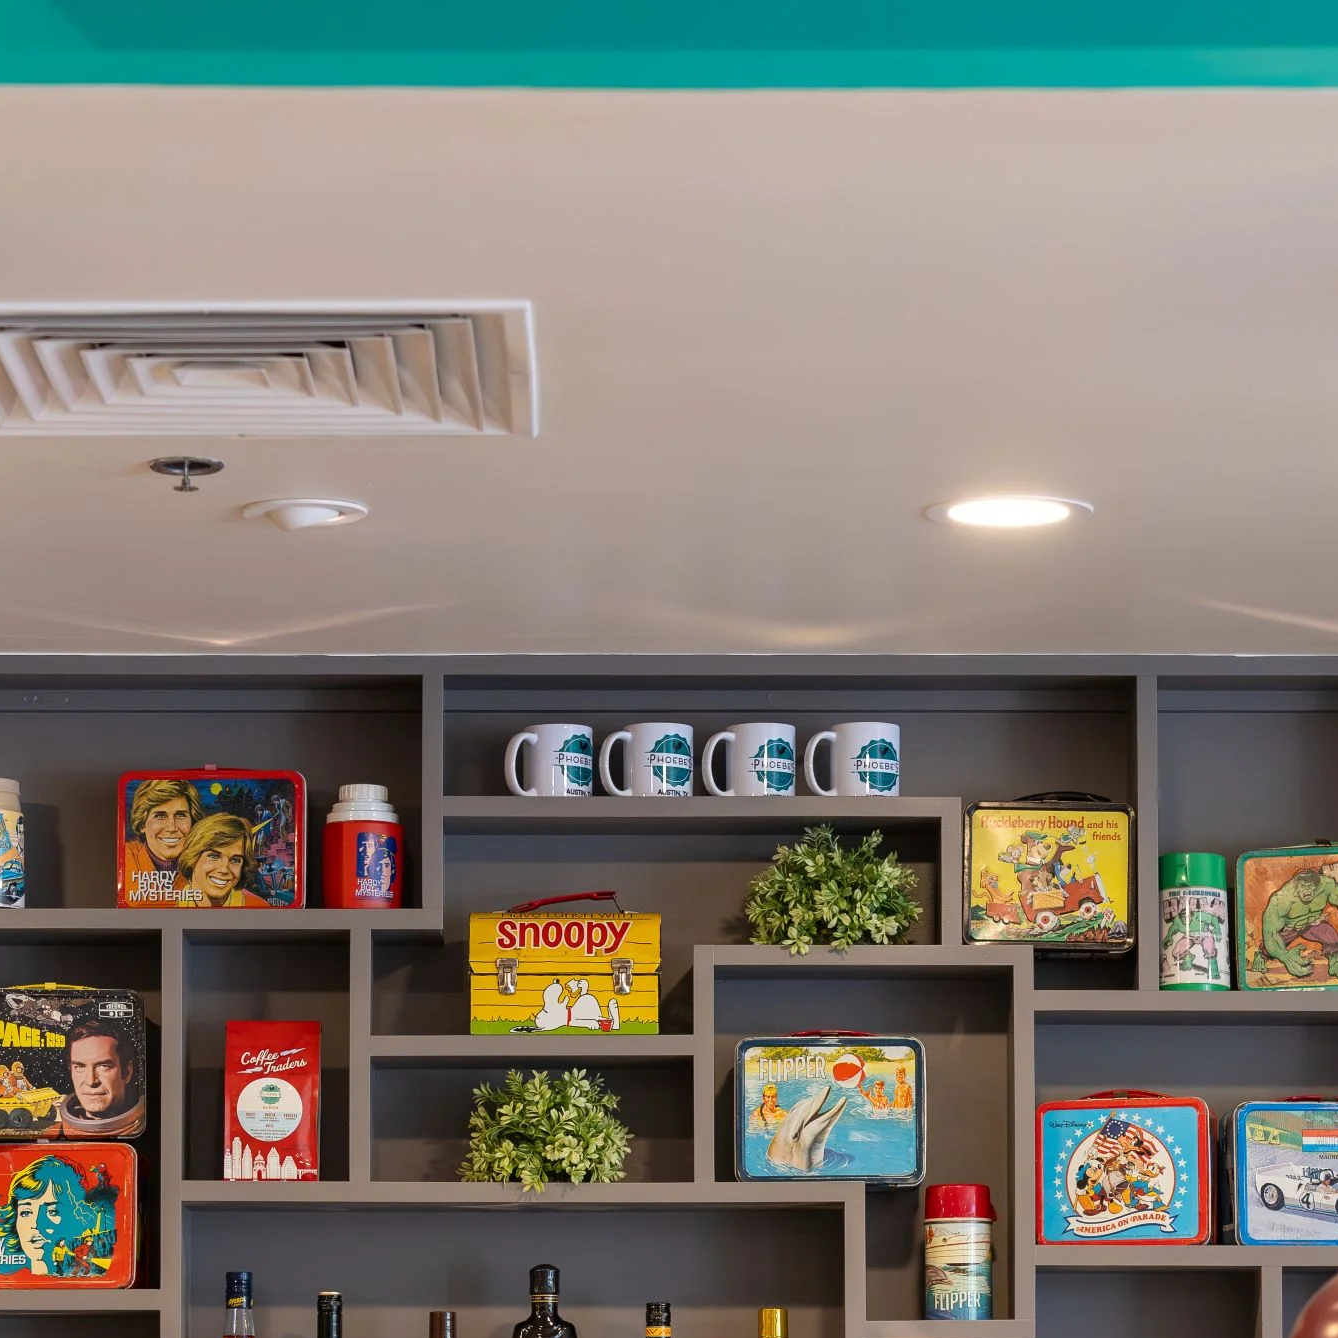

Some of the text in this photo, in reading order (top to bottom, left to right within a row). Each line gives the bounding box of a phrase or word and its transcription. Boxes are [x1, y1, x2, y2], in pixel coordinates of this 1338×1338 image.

[981, 816, 1046, 831] Huckleberry
[1048, 816, 1084, 829] Hound
[1106, 820, 1118, 828] his
[1092, 832, 1121, 841] friends
[132, 871, 177, 882] HARDY
[357, 878, 382, 886] HARDY
[139, 881, 172, 891] BOYS
[355, 889, 394, 898] MYSTERIES
[129, 890, 202, 902] MYSTERIES
[497, 920, 632, 956] snoopy
[47, 1031, 66, 1047] 1999
[241, 1049, 280, 1066] Coffee
[263, 1057, 307, 1074] Traders
[758, 1056, 826, 1082] FLIPPER
[1301, 1193, 1311, 1209] 4
[1076, 1224, 1116, 1234] AMERICA
[1130, 1213, 1167, 1223] PARADE
[934, 1290, 980, 1310] FLIPPER
